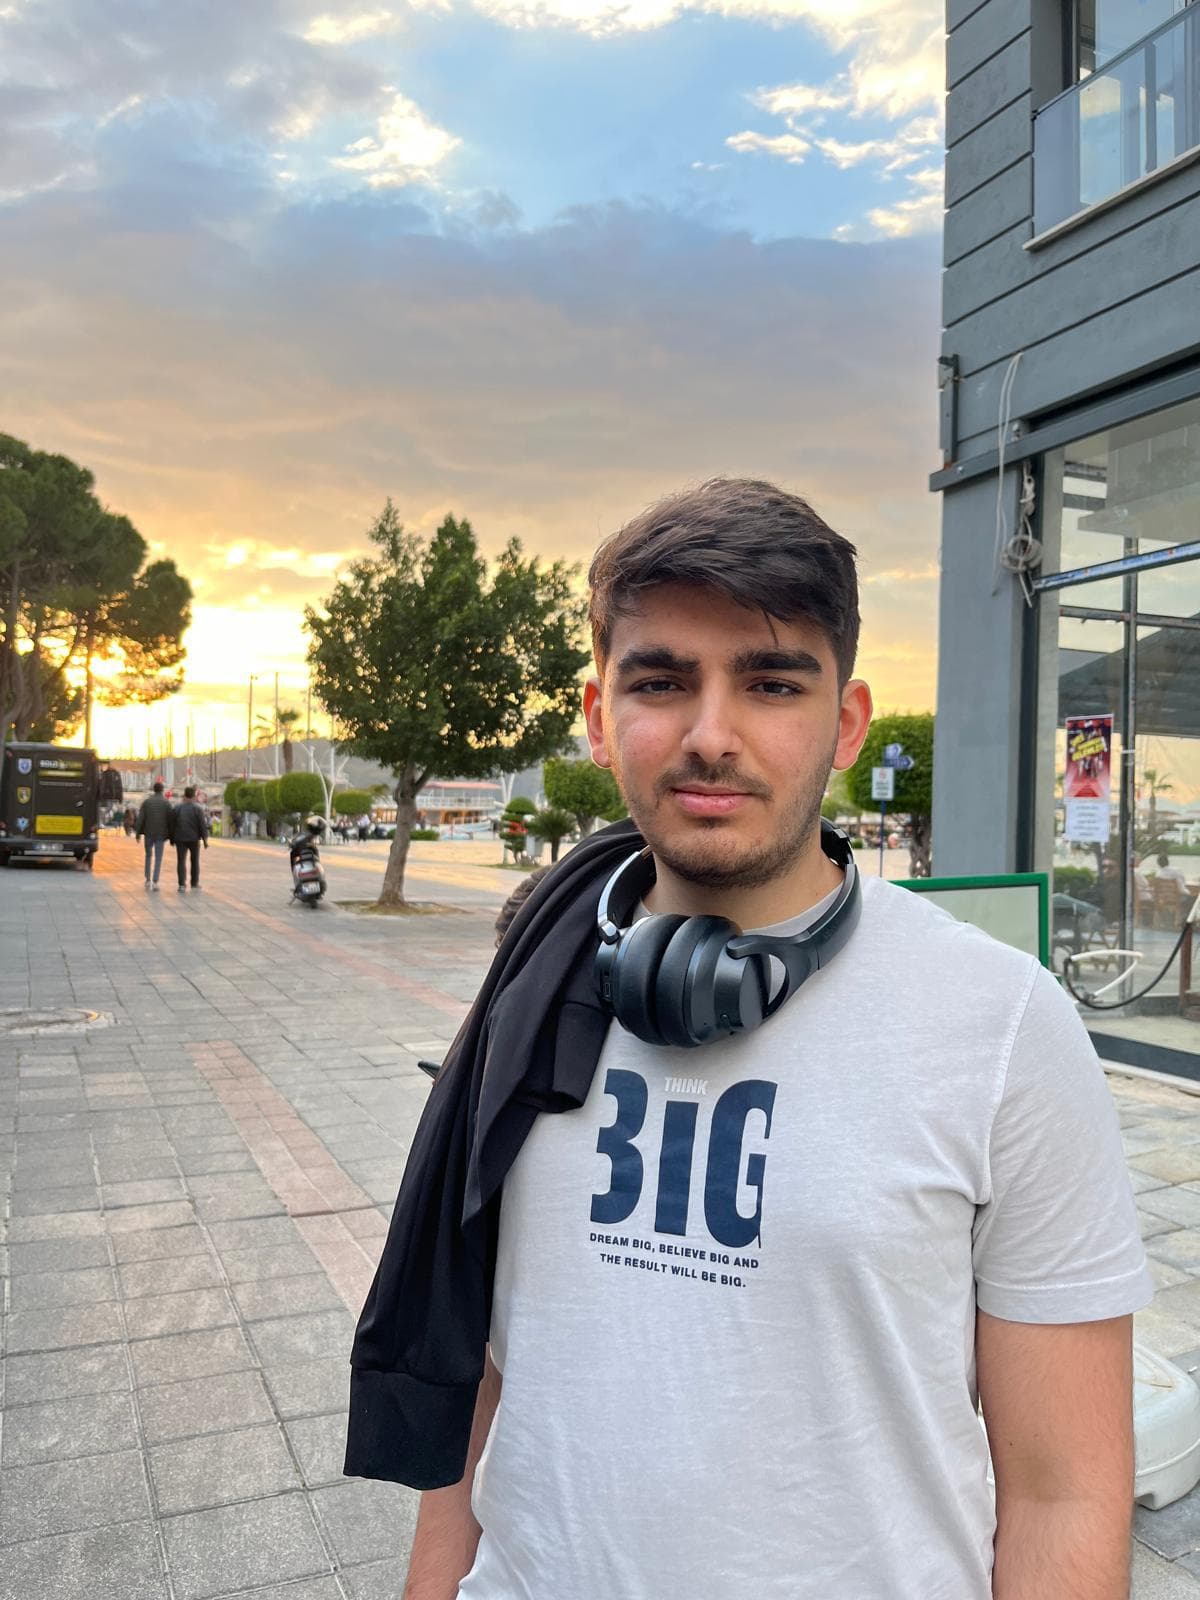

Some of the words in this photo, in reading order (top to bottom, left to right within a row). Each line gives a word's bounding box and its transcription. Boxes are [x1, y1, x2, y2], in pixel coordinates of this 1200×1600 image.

[664, 1076, 709, 1095] THINK
[590, 1068, 778, 1248] BIG
[589, 1232, 629, 1247] DREAM
[632, 1239, 656, 1253] BIG,
[659, 1243, 706, 1260] BELIEVE
[710, 1252, 730, 1265] BIG
[733, 1256, 759, 1269] AND
[600, 1253, 621, 1265] THE
[624, 1257, 668, 1273] RESULT
[671, 1265, 698, 1278] WILL
[701, 1271, 717, 1283] BE
[721, 1274, 747, 1288] BIG.
